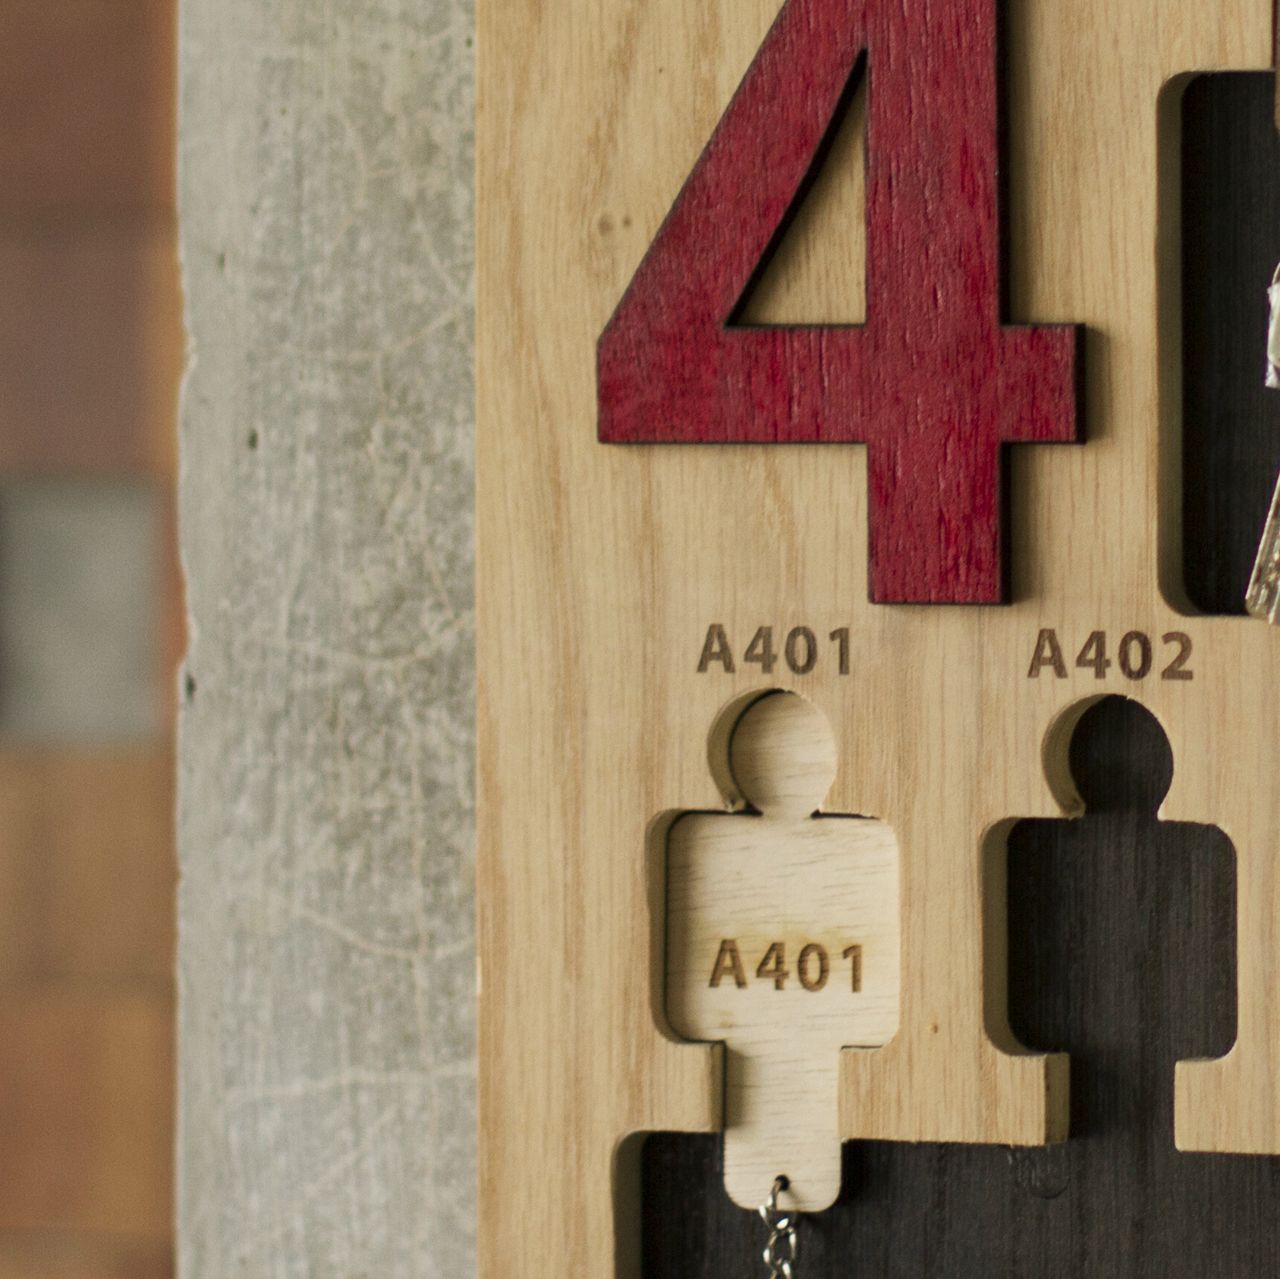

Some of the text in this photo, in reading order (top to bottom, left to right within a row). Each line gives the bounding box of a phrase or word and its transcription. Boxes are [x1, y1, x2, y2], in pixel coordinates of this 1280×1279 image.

[697, 623, 851, 675] A401
[1028, 628, 1194, 681] A402
[709, 939, 864, 993] A401
